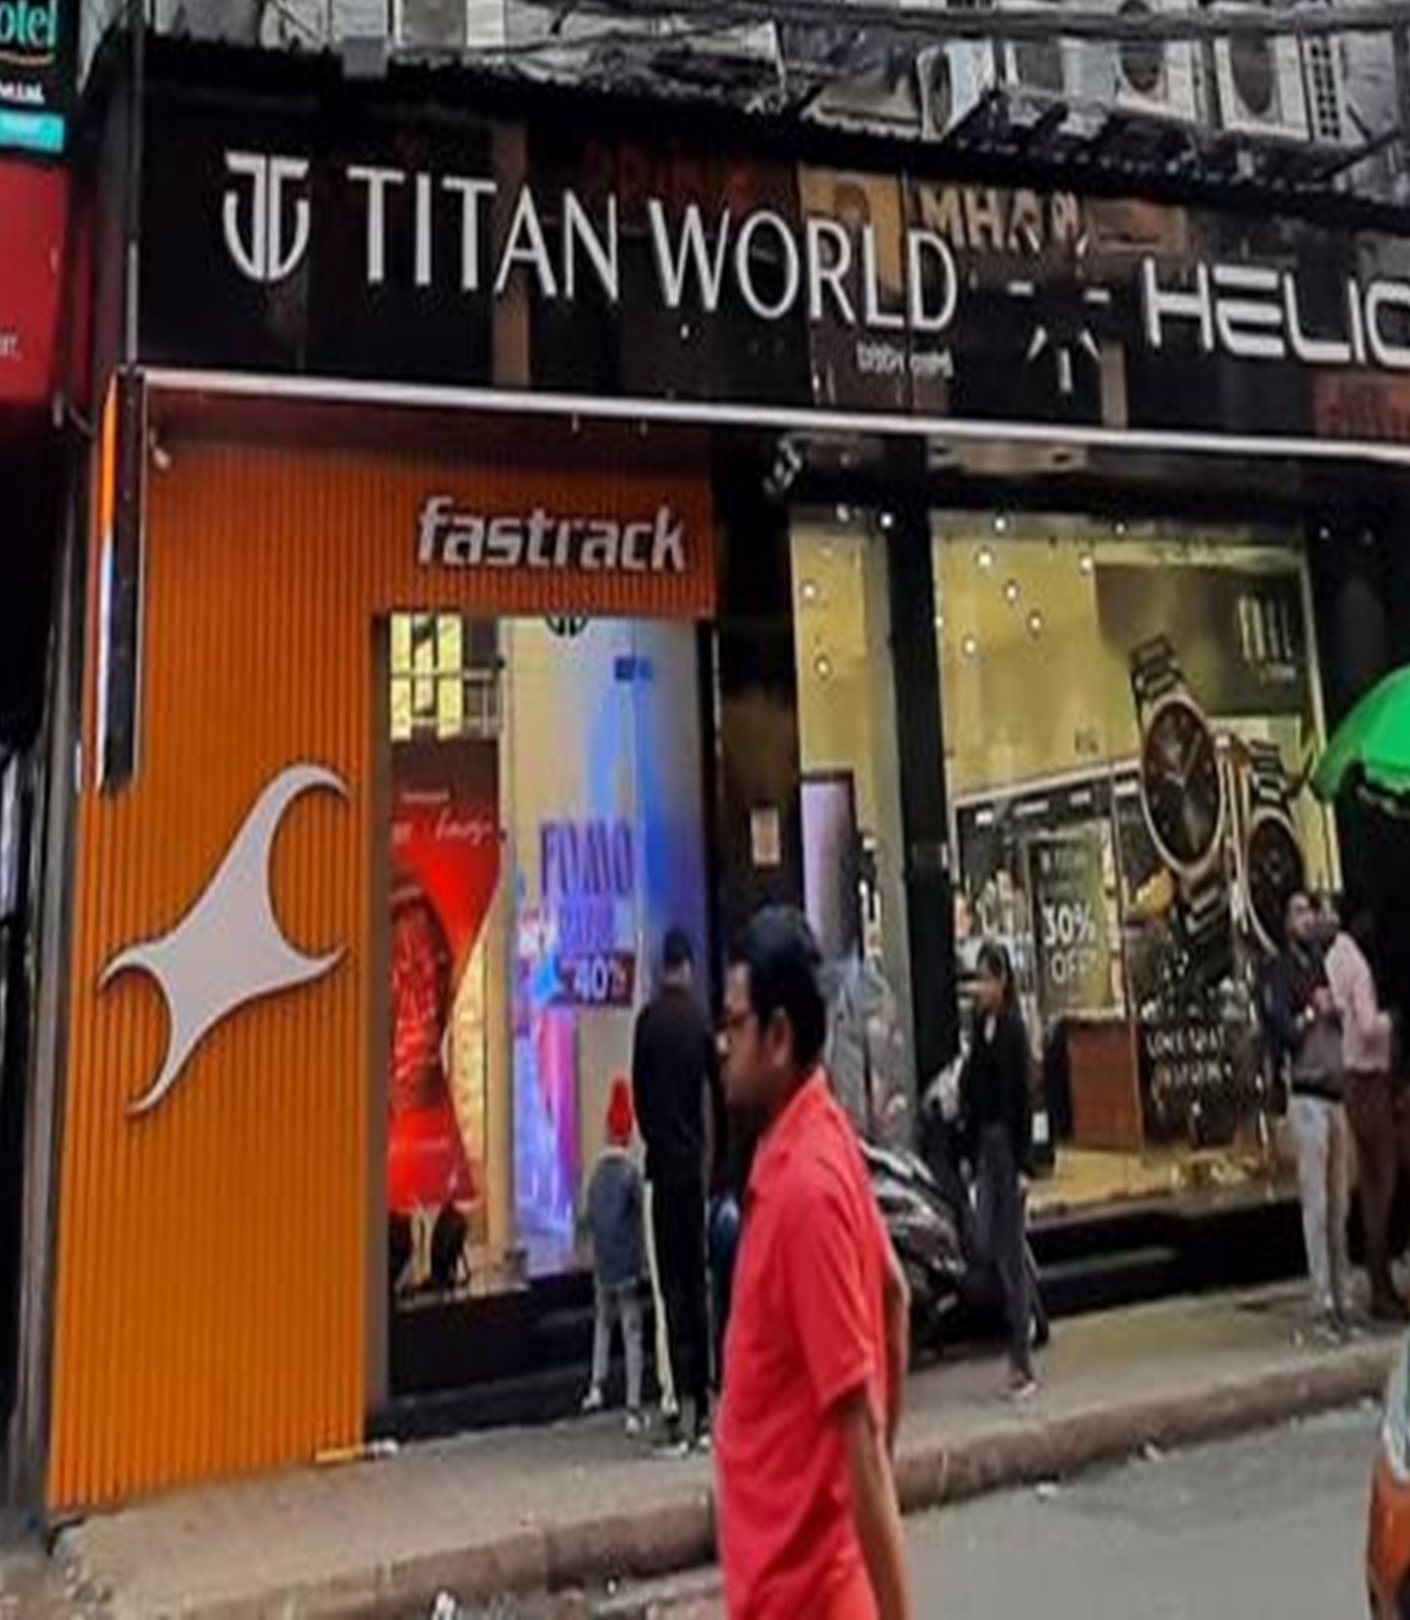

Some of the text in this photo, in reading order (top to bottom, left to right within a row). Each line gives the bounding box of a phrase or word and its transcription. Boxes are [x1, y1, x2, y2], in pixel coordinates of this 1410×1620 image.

[346, 165, 622, 302] TITAN
[647, 198, 959, 333] WORLD
[417, 495, 686, 572] fastrack
